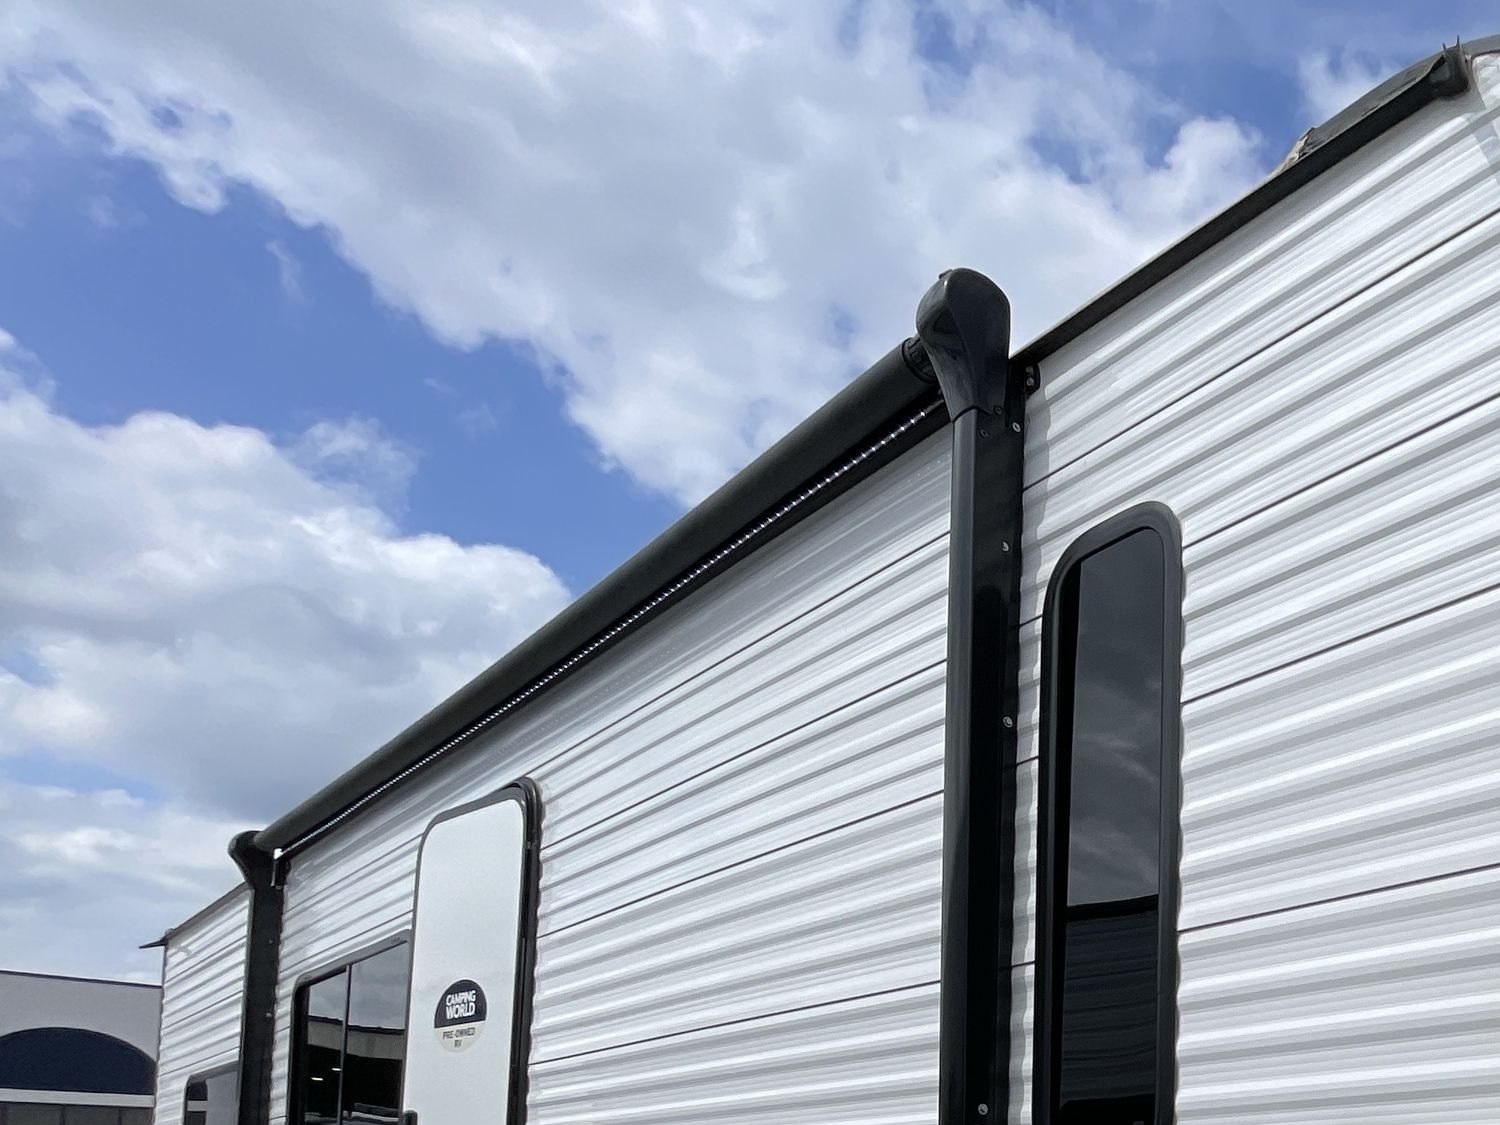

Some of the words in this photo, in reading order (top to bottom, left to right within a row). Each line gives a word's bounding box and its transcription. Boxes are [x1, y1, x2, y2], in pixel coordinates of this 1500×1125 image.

[446, 990, 476, 1006] CAMPING
[446, 1002, 476, 1020] WORLD
[442, 1027, 476, 1040] PRE-OWNED
